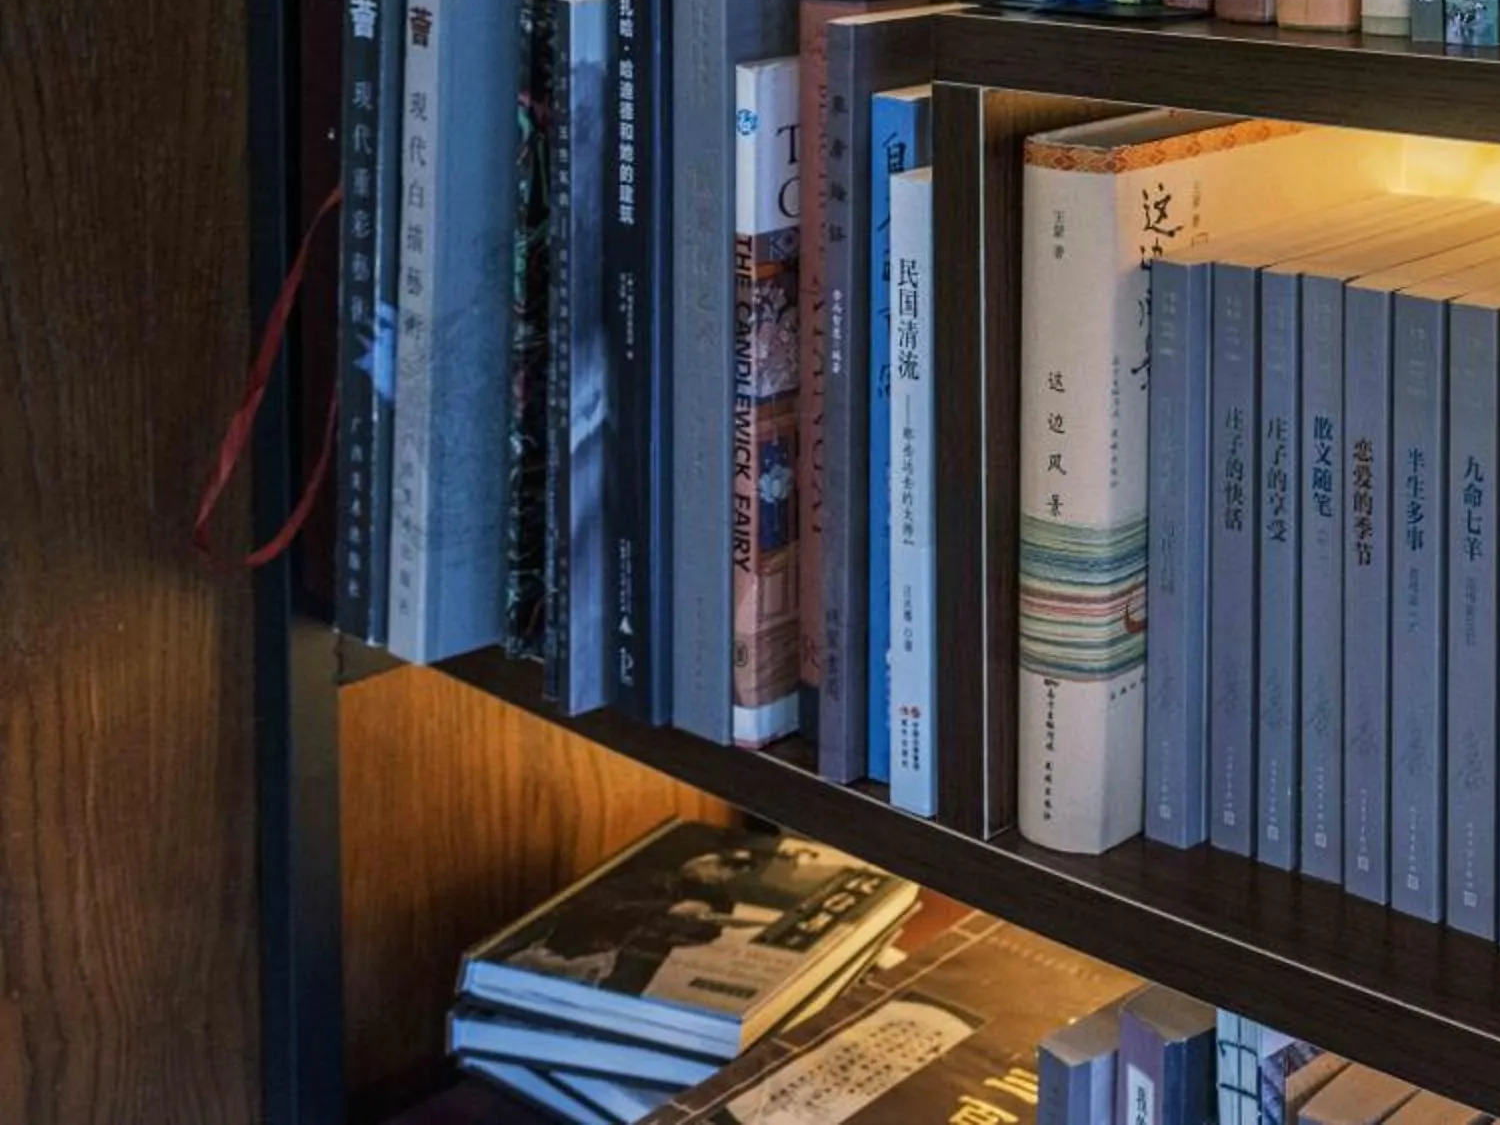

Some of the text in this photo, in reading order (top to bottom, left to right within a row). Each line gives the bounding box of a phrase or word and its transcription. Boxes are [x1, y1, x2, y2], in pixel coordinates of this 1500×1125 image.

[733, 237, 754, 573] THE CANDLEWICK FAIRY
[1047, 371, 1067, 516] 这边风景
[1312, 415, 1334, 519] 散文随笔
[1406, 447, 1425, 552] 半生多事
[1463, 455, 1484, 563] 九命七羊
